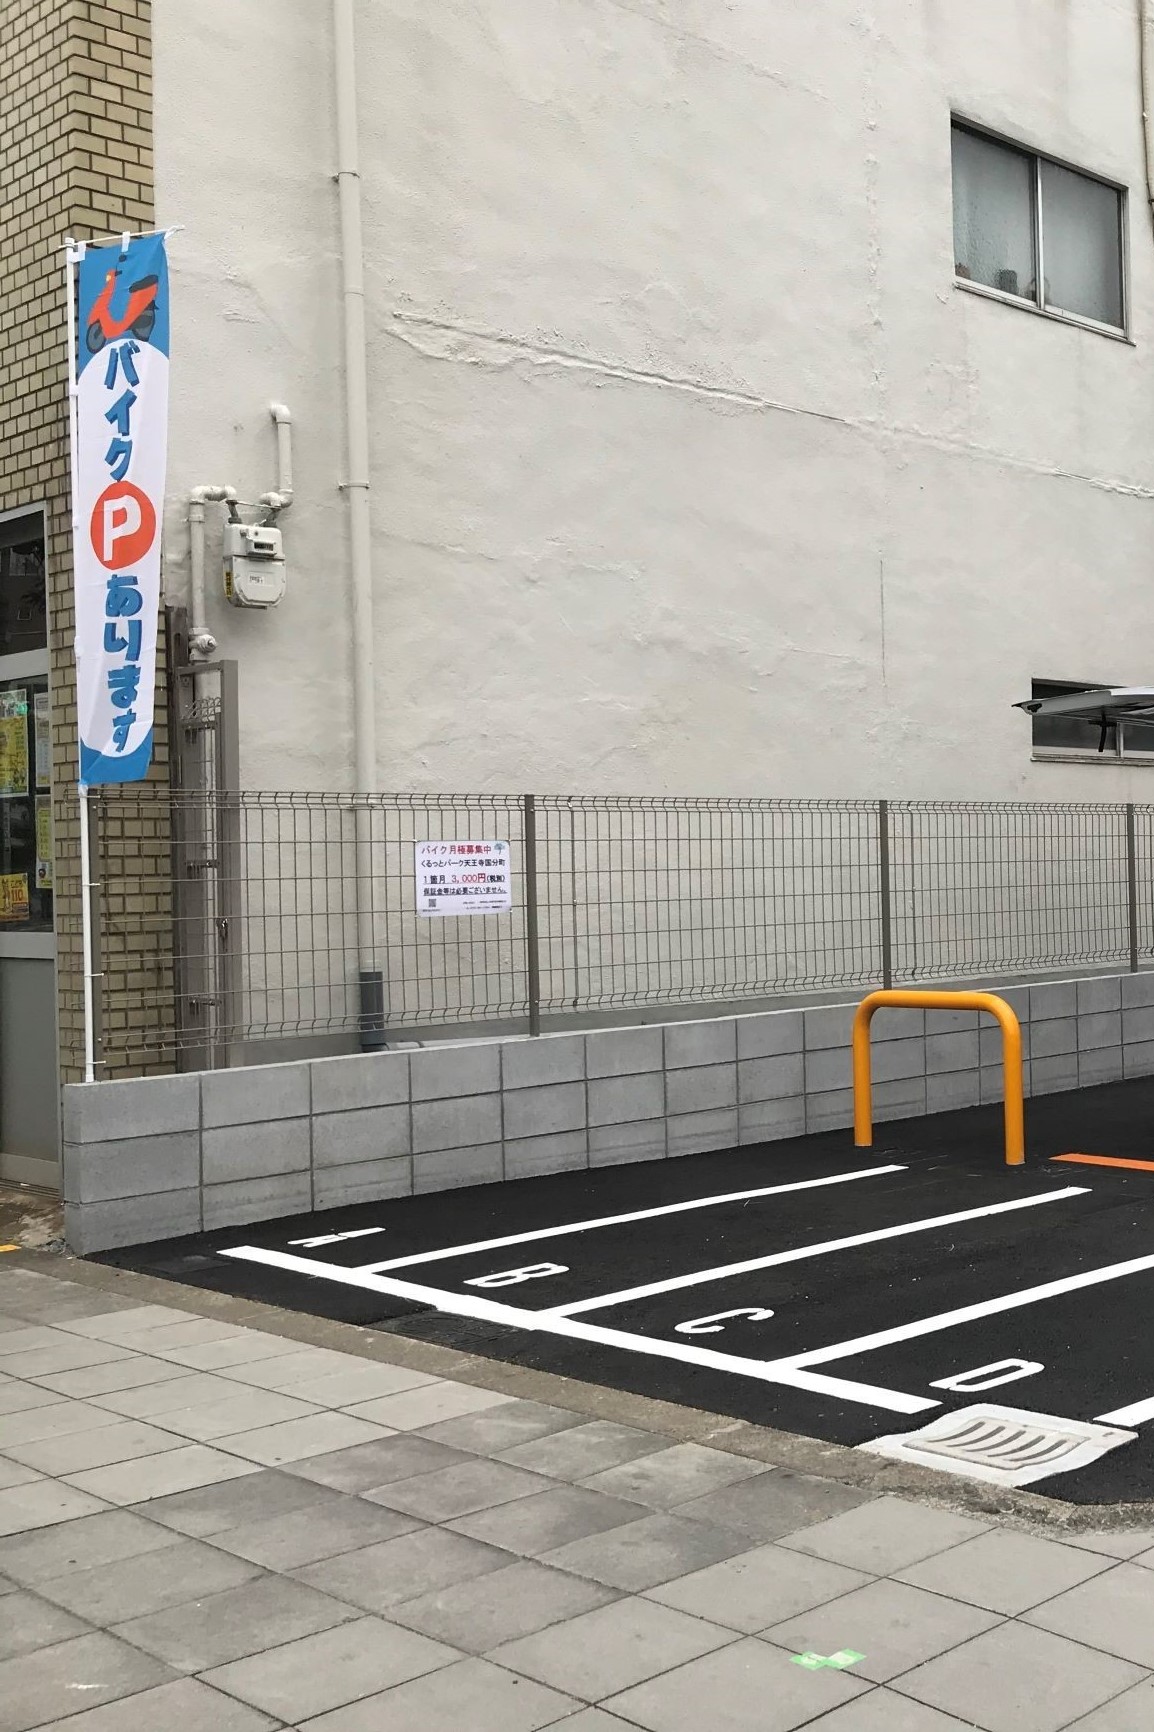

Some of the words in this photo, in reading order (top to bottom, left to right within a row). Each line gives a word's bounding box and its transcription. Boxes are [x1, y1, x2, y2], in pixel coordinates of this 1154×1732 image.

[104, 340, 141, 481] バイク
[102, 494, 142, 562] P
[103, 573, 145, 753] あります
[421, 859, 505, 867] くるっとパーク天王寺国分町
[463, 1262, 570, 1288] B
[674, 1307, 774, 1334] C
[929, 1358, 1045, 1392] D
